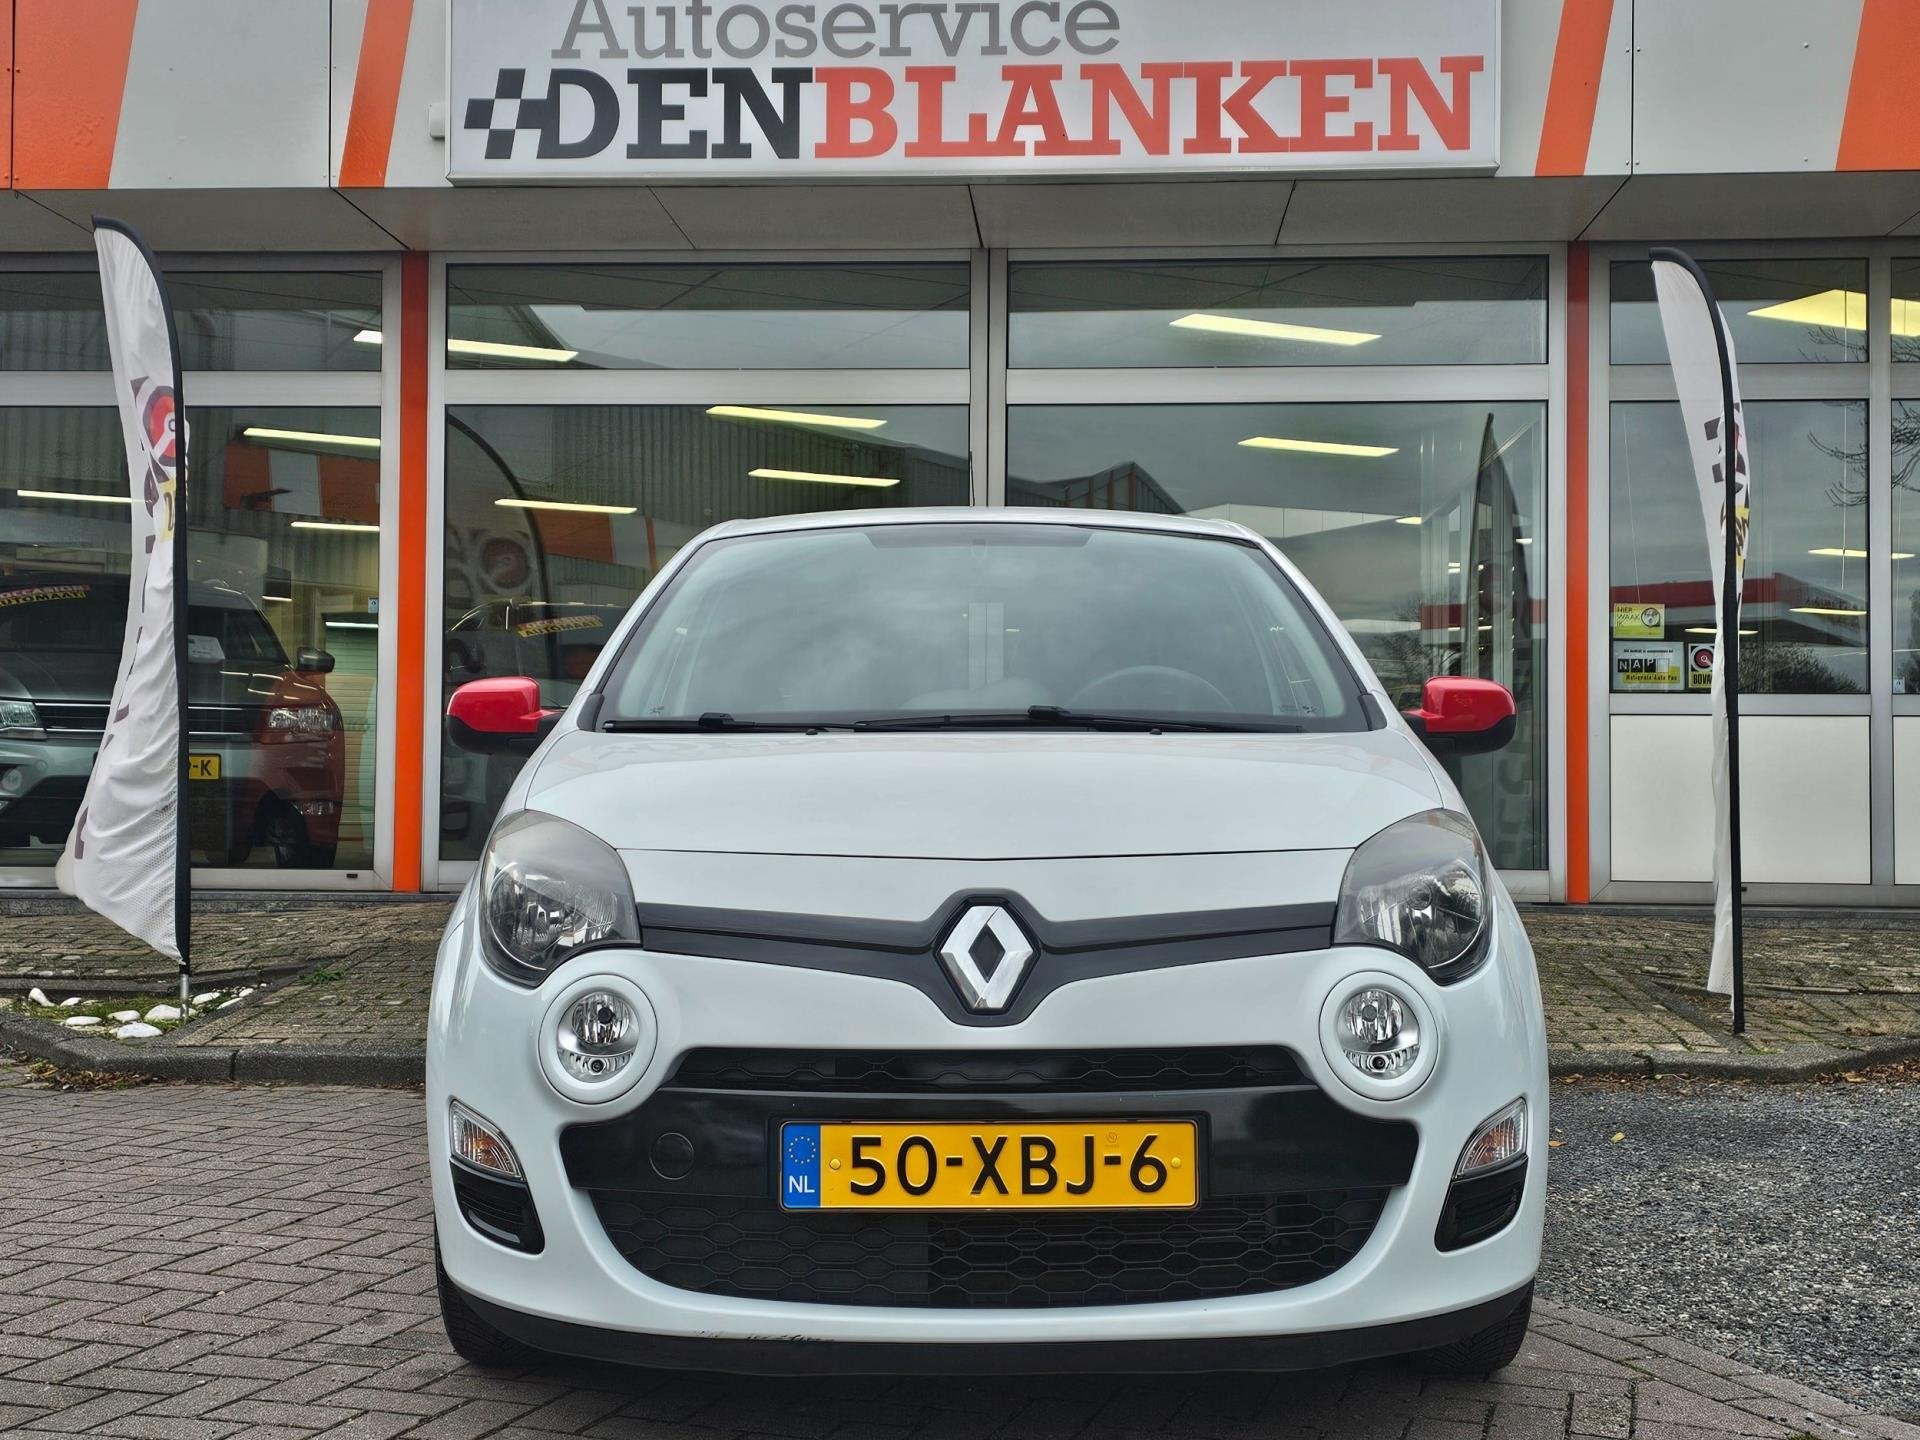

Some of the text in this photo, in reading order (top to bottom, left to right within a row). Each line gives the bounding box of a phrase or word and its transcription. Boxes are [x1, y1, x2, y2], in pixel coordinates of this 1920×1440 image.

[551, 0, 1120, 59] Autoservice
[1619, 659, 1654, 670] NAP
[1693, 673, 1713, 685] BOVA
[849, 1135, 1169, 1196] 50-XBJ-6
[788, 1175, 816, 1194] NL
